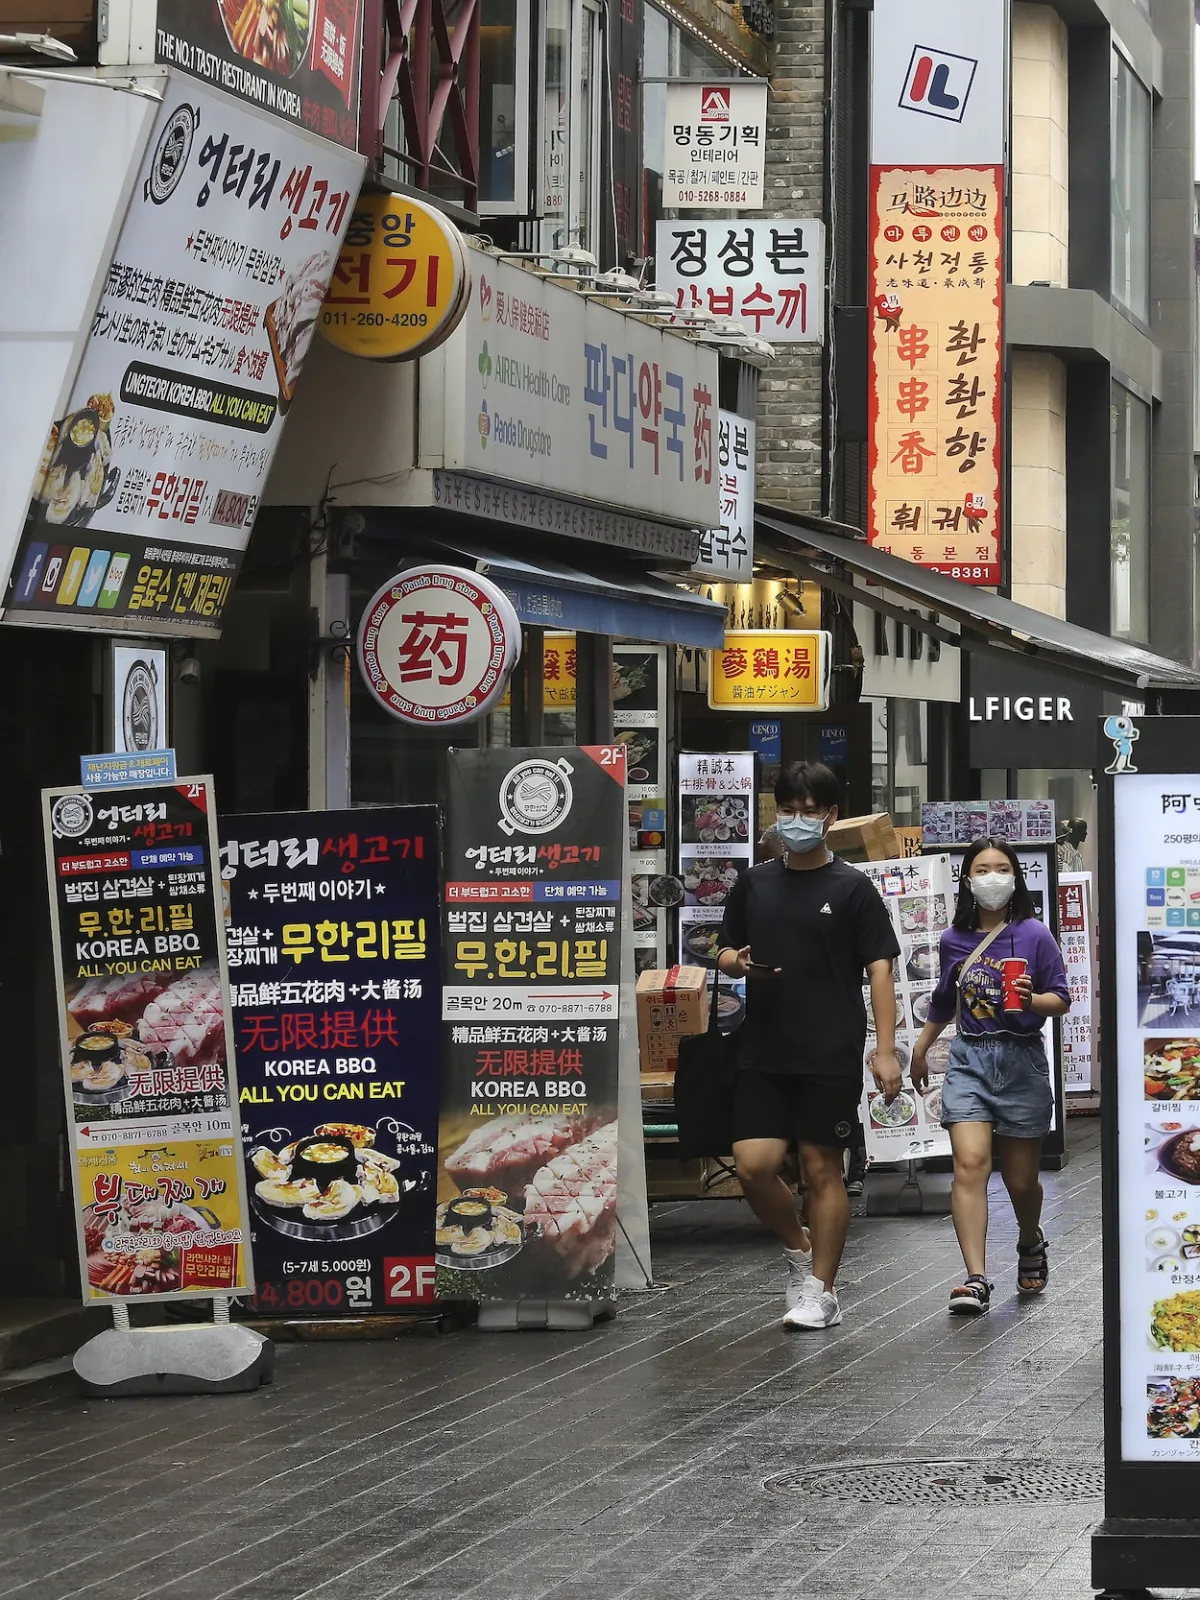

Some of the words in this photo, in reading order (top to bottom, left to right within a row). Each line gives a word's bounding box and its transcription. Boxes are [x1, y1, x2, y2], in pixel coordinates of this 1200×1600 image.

[157, 30, 174, 60] THE
[175, 38, 194, 69] NO.1
[196, 48, 222, 82] TASTY
[222, 60, 267, 102] RESTURANT
[268, 82, 278, 107] IN
[277, 85, 301, 119] KOREA
[673, 125, 759, 147] 명동기획
[690, 149, 738, 163] 인테리어
[678, 190, 747, 203] 010-5268-0884
[886, 181, 988, 214] 马路边边
[670, 228, 809, 277] 정성본
[325, 253, 440, 308] 전기
[323, 312, 428, 327] 011-260-4209
[494, 353, 523, 392] AIREN
[522, 362, 551, 397] Health
[551, 373, 572, 406] Care
[125, 371, 169, 401] UNGTEORI
[167, 381, 198, 408] KOREA
[193, 388, 213, 412] BBQ
[210, 394, 224, 414] ALL
[225, 396, 244, 418] YOU
[241, 400, 260, 423] CAN
[257, 403, 276, 425] EAT
[584, 342, 686, 483] 판다약국
[889, 323, 937, 475] 串串香
[493, 412, 518, 447] Panda
[517, 420, 552, 459] Drugstore
[891, 503, 963, 532] 훠궈
[402, 575, 431, 593] Panda
[432, 575, 454, 589] Drug
[456, 582, 478, 601] store
[398, 610, 469, 686] 药
[969, 697, 1075, 722] LFIGER
[752, 724, 778, 735] CESCO
[76, 938, 149, 961] KOREA
[154, 933, 200, 954] BBQ
[281, 919, 426, 964] 무한리필
[454, 938, 607, 979] 무.한.리.필
[446, 996, 488, 1012] 골목안
[492, 998, 522, 1011] 20m
[538, 1003, 613, 1014] 070-8871-6788
[241, 1008, 399, 1053] 无限提供
[239, 1087, 274, 1104] ALL
[276, 1084, 318, 1102] YOU
[324, 1082, 366, 1100] CAN
[369, 1081, 405, 1099] EAT
[909, 1139, 934, 1154] 2F
[389, 1265, 436, 1298] 2F
